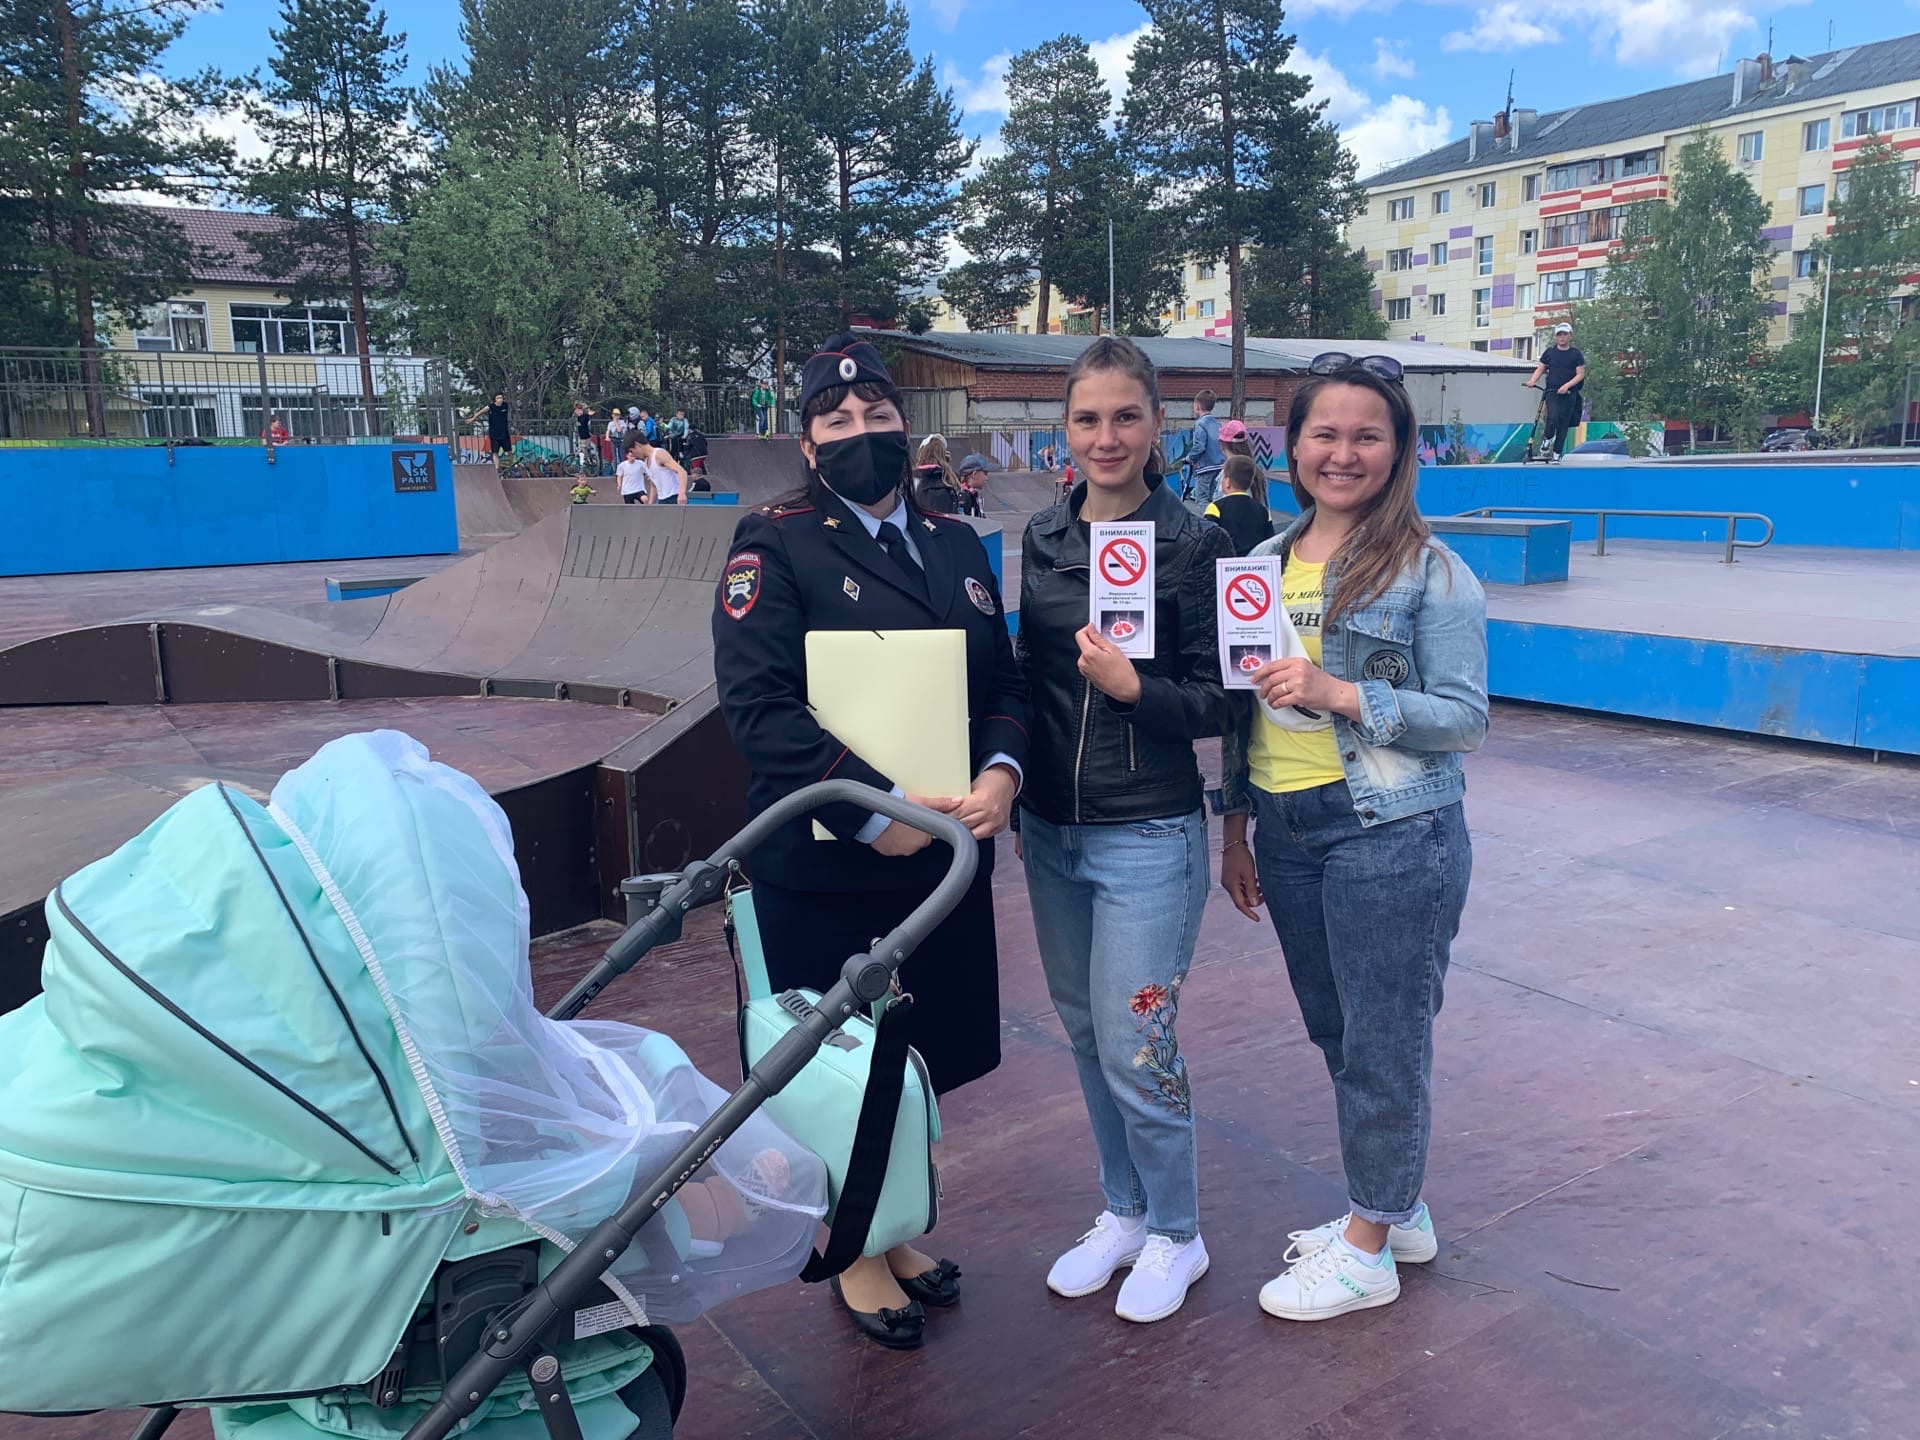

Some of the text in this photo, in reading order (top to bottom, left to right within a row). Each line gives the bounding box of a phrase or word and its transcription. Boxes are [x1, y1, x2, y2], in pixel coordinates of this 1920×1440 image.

[412, 467, 428, 477] SK
[401, 476, 429, 484] PARK
[1099, 529, 1147, 537] ВНИМАНИЕ!
[1224, 565, 1270, 573] ВНИМАНИЕ!
[1376, 660, 1397, 677] NYC
